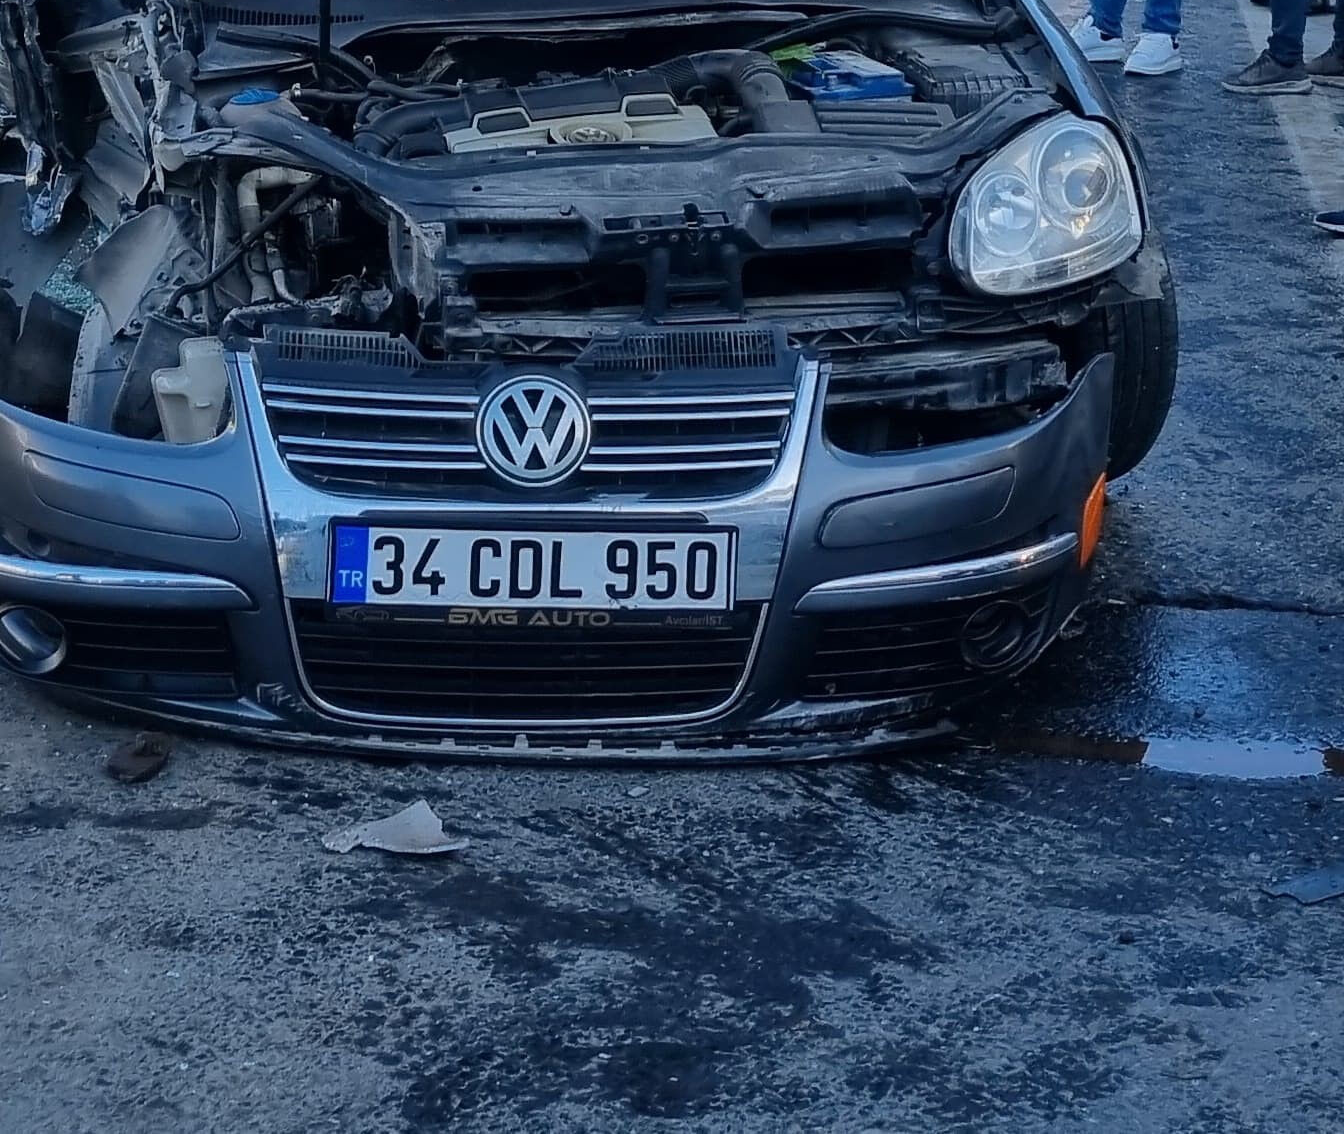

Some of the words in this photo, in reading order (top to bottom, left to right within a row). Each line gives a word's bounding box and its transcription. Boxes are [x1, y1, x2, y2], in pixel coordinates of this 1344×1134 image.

[338, 569, 364, 588] TR
[372, 534, 446, 597] 34
[469, 537, 584, 600] CDL
[604, 538, 718, 601] 950
[527, 609, 611, 627] AUTO
